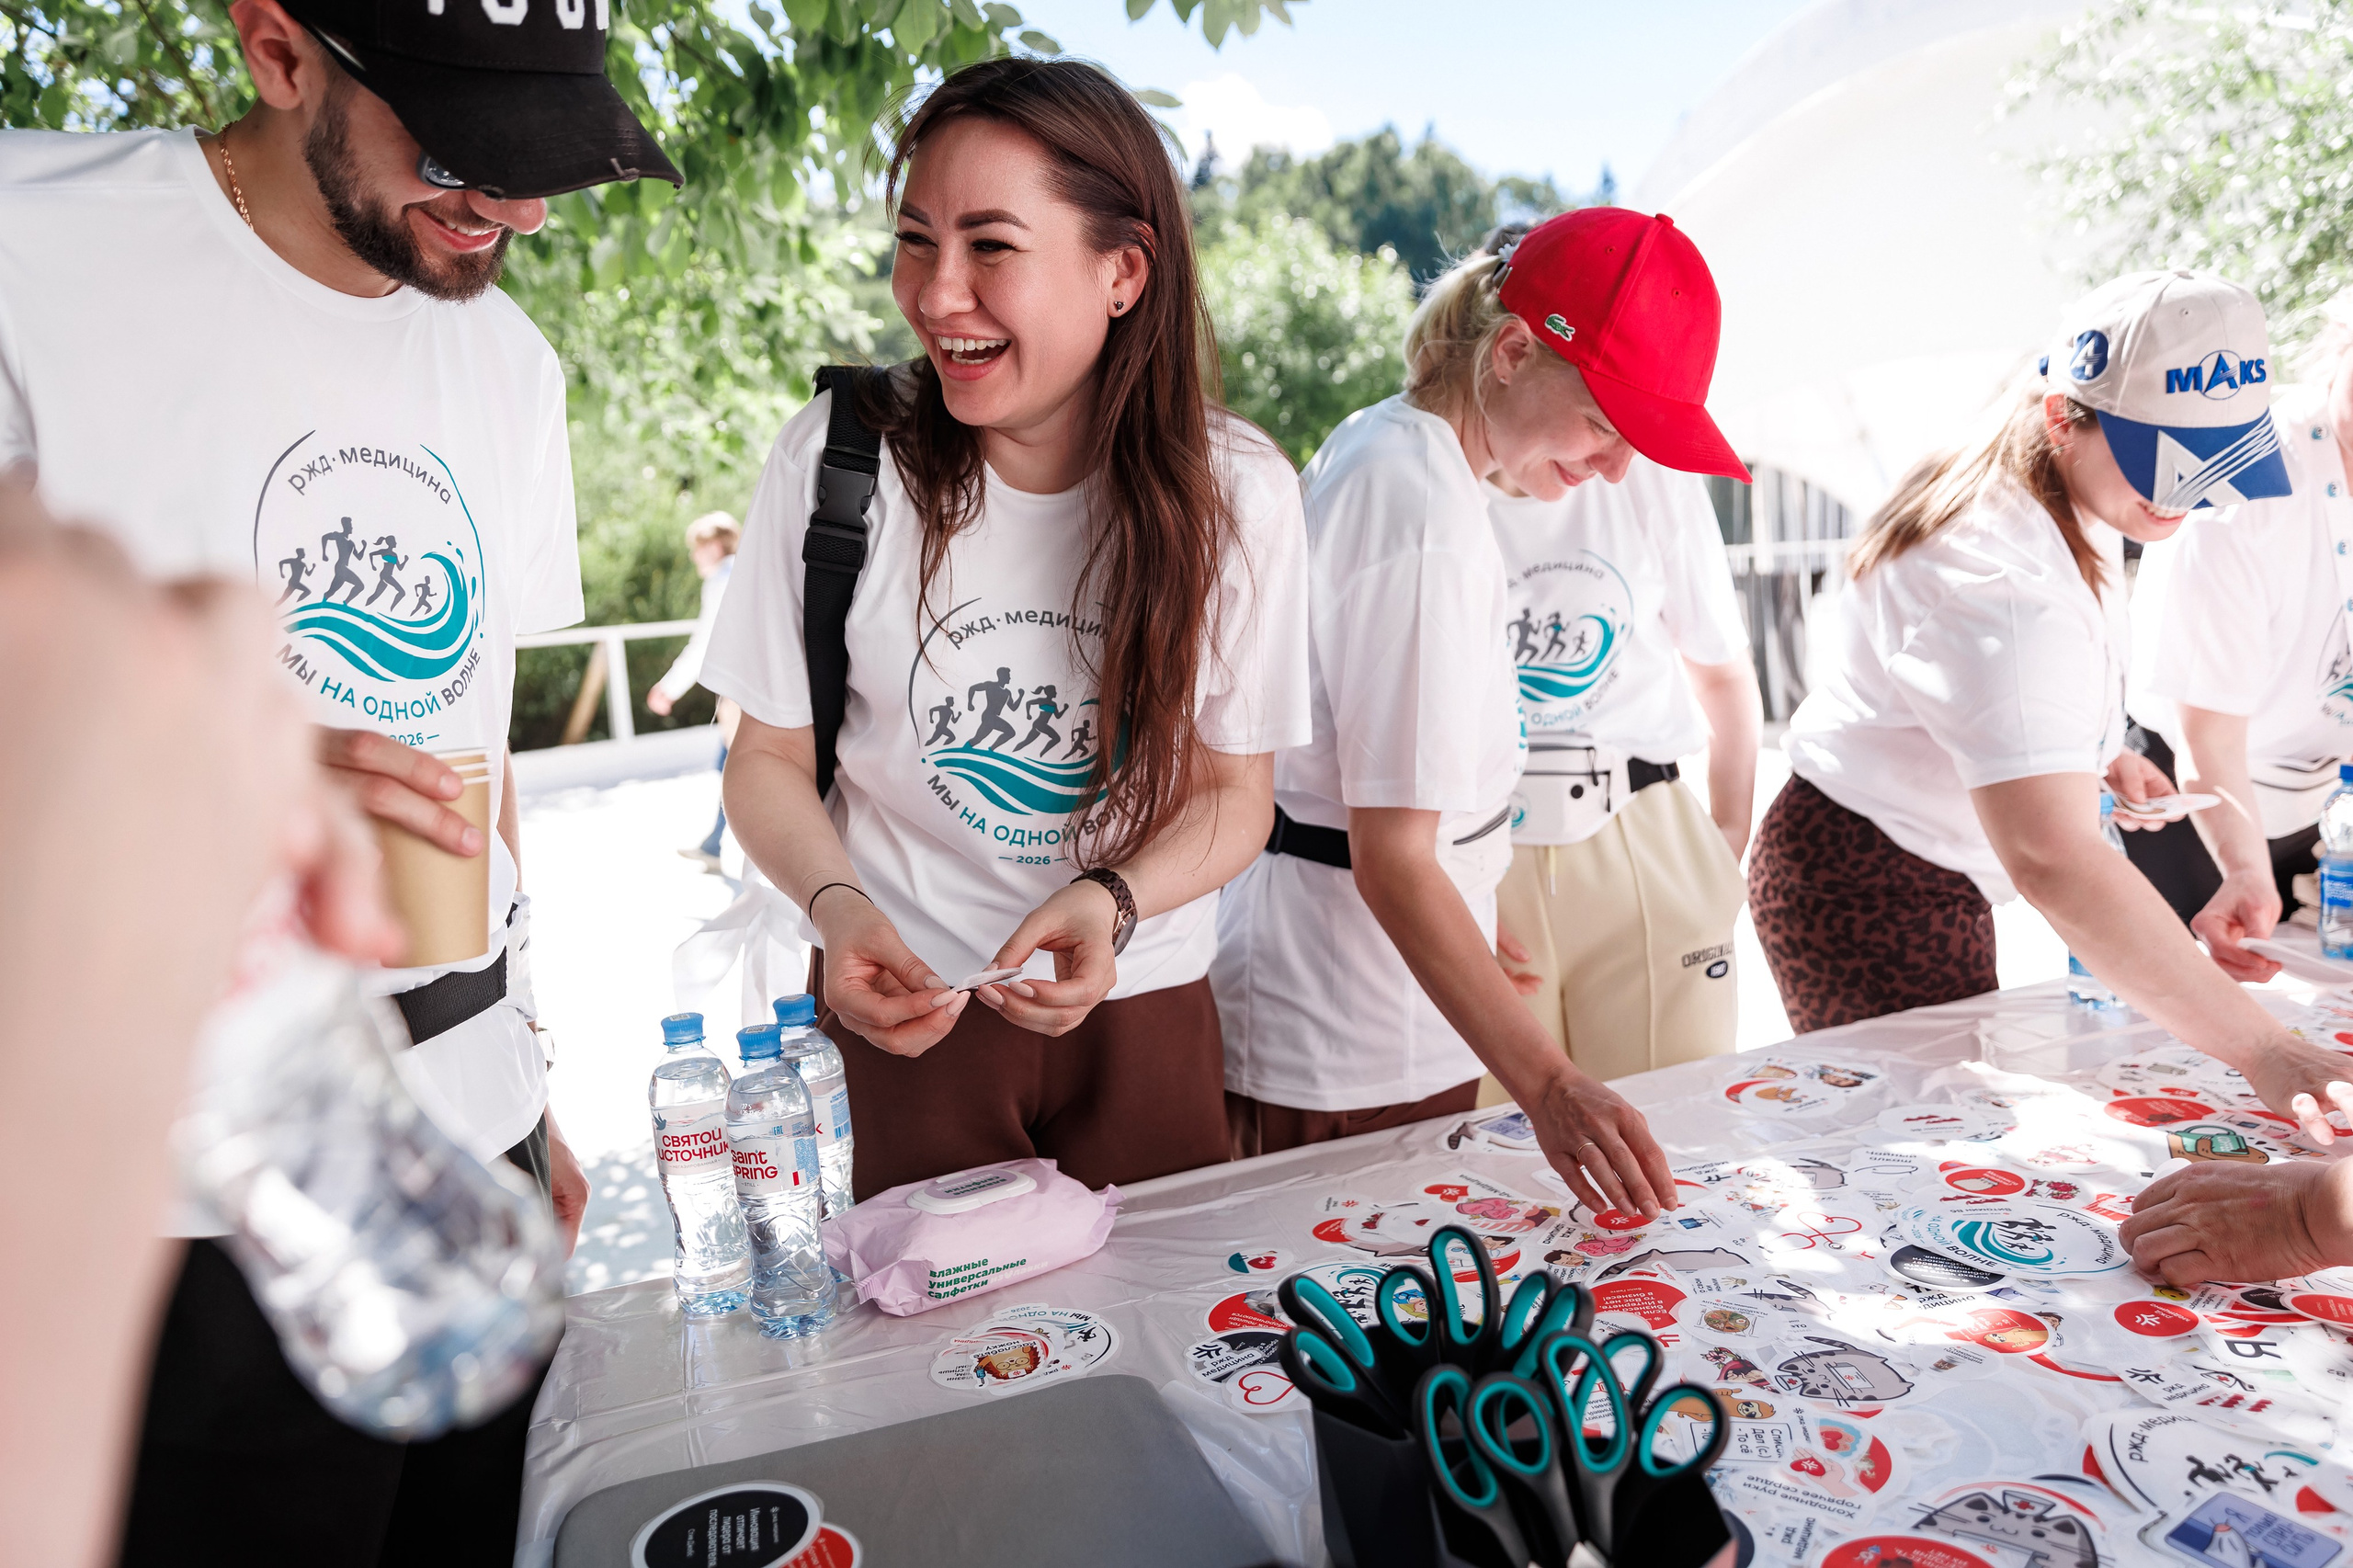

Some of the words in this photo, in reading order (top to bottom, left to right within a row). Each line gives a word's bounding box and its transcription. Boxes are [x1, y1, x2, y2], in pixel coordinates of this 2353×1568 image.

[320, 676, 356, 708] НА
[363, 691, 441, 722] ОДНОЙ
[441, 648, 481, 706] ВОЛНЕ
[1584, 667, 1619, 710] ВОЛНЕ
[926, 774, 961, 812] МЫ
[959, 805, 987, 835] НА
[993, 823, 1077, 848] ОДНОЙ
[1016, 855, 1051, 865] 2026
[1946, 1245, 1998, 1267] ВОЛНЕ
[928, 1258, 1027, 1290] универсальные
[929, 1258, 989, 1278] влажные
[927, 1279, 989, 1300] салфетки
[1599, 1301, 1655, 1310] Интернете,
[1069, 1312, 1092, 1322] МЫ
[1228, 1316, 1256, 1326] лошади
[1232, 1312, 1288, 1329] оборачиваются
[973, 1341, 1037, 1358] Расслабьте
[986, 1340, 1020, 1351] ножку
[1201, 1353, 1255, 1377] медицина
[1211, 1355, 1234, 1367] ржд
[2163, 1382, 2187, 1393] ржд
[2163, 1383, 2211, 1402] медицина
[1743, 1482, 1778, 1497] руки
[1746, 1474, 1799, 1494] сердце
[1780, 1492, 1856, 1519] Холодные
[1801, 1489, 1861, 1510] горячее
[721, 1516, 733, 1544] лидера
[734, 1514, 745, 1550] отличает
[749, 1506, 761, 1551] Инновация
[1793, 1517, 1817, 1560] медицина
[722, 1544, 732, 1555] от
